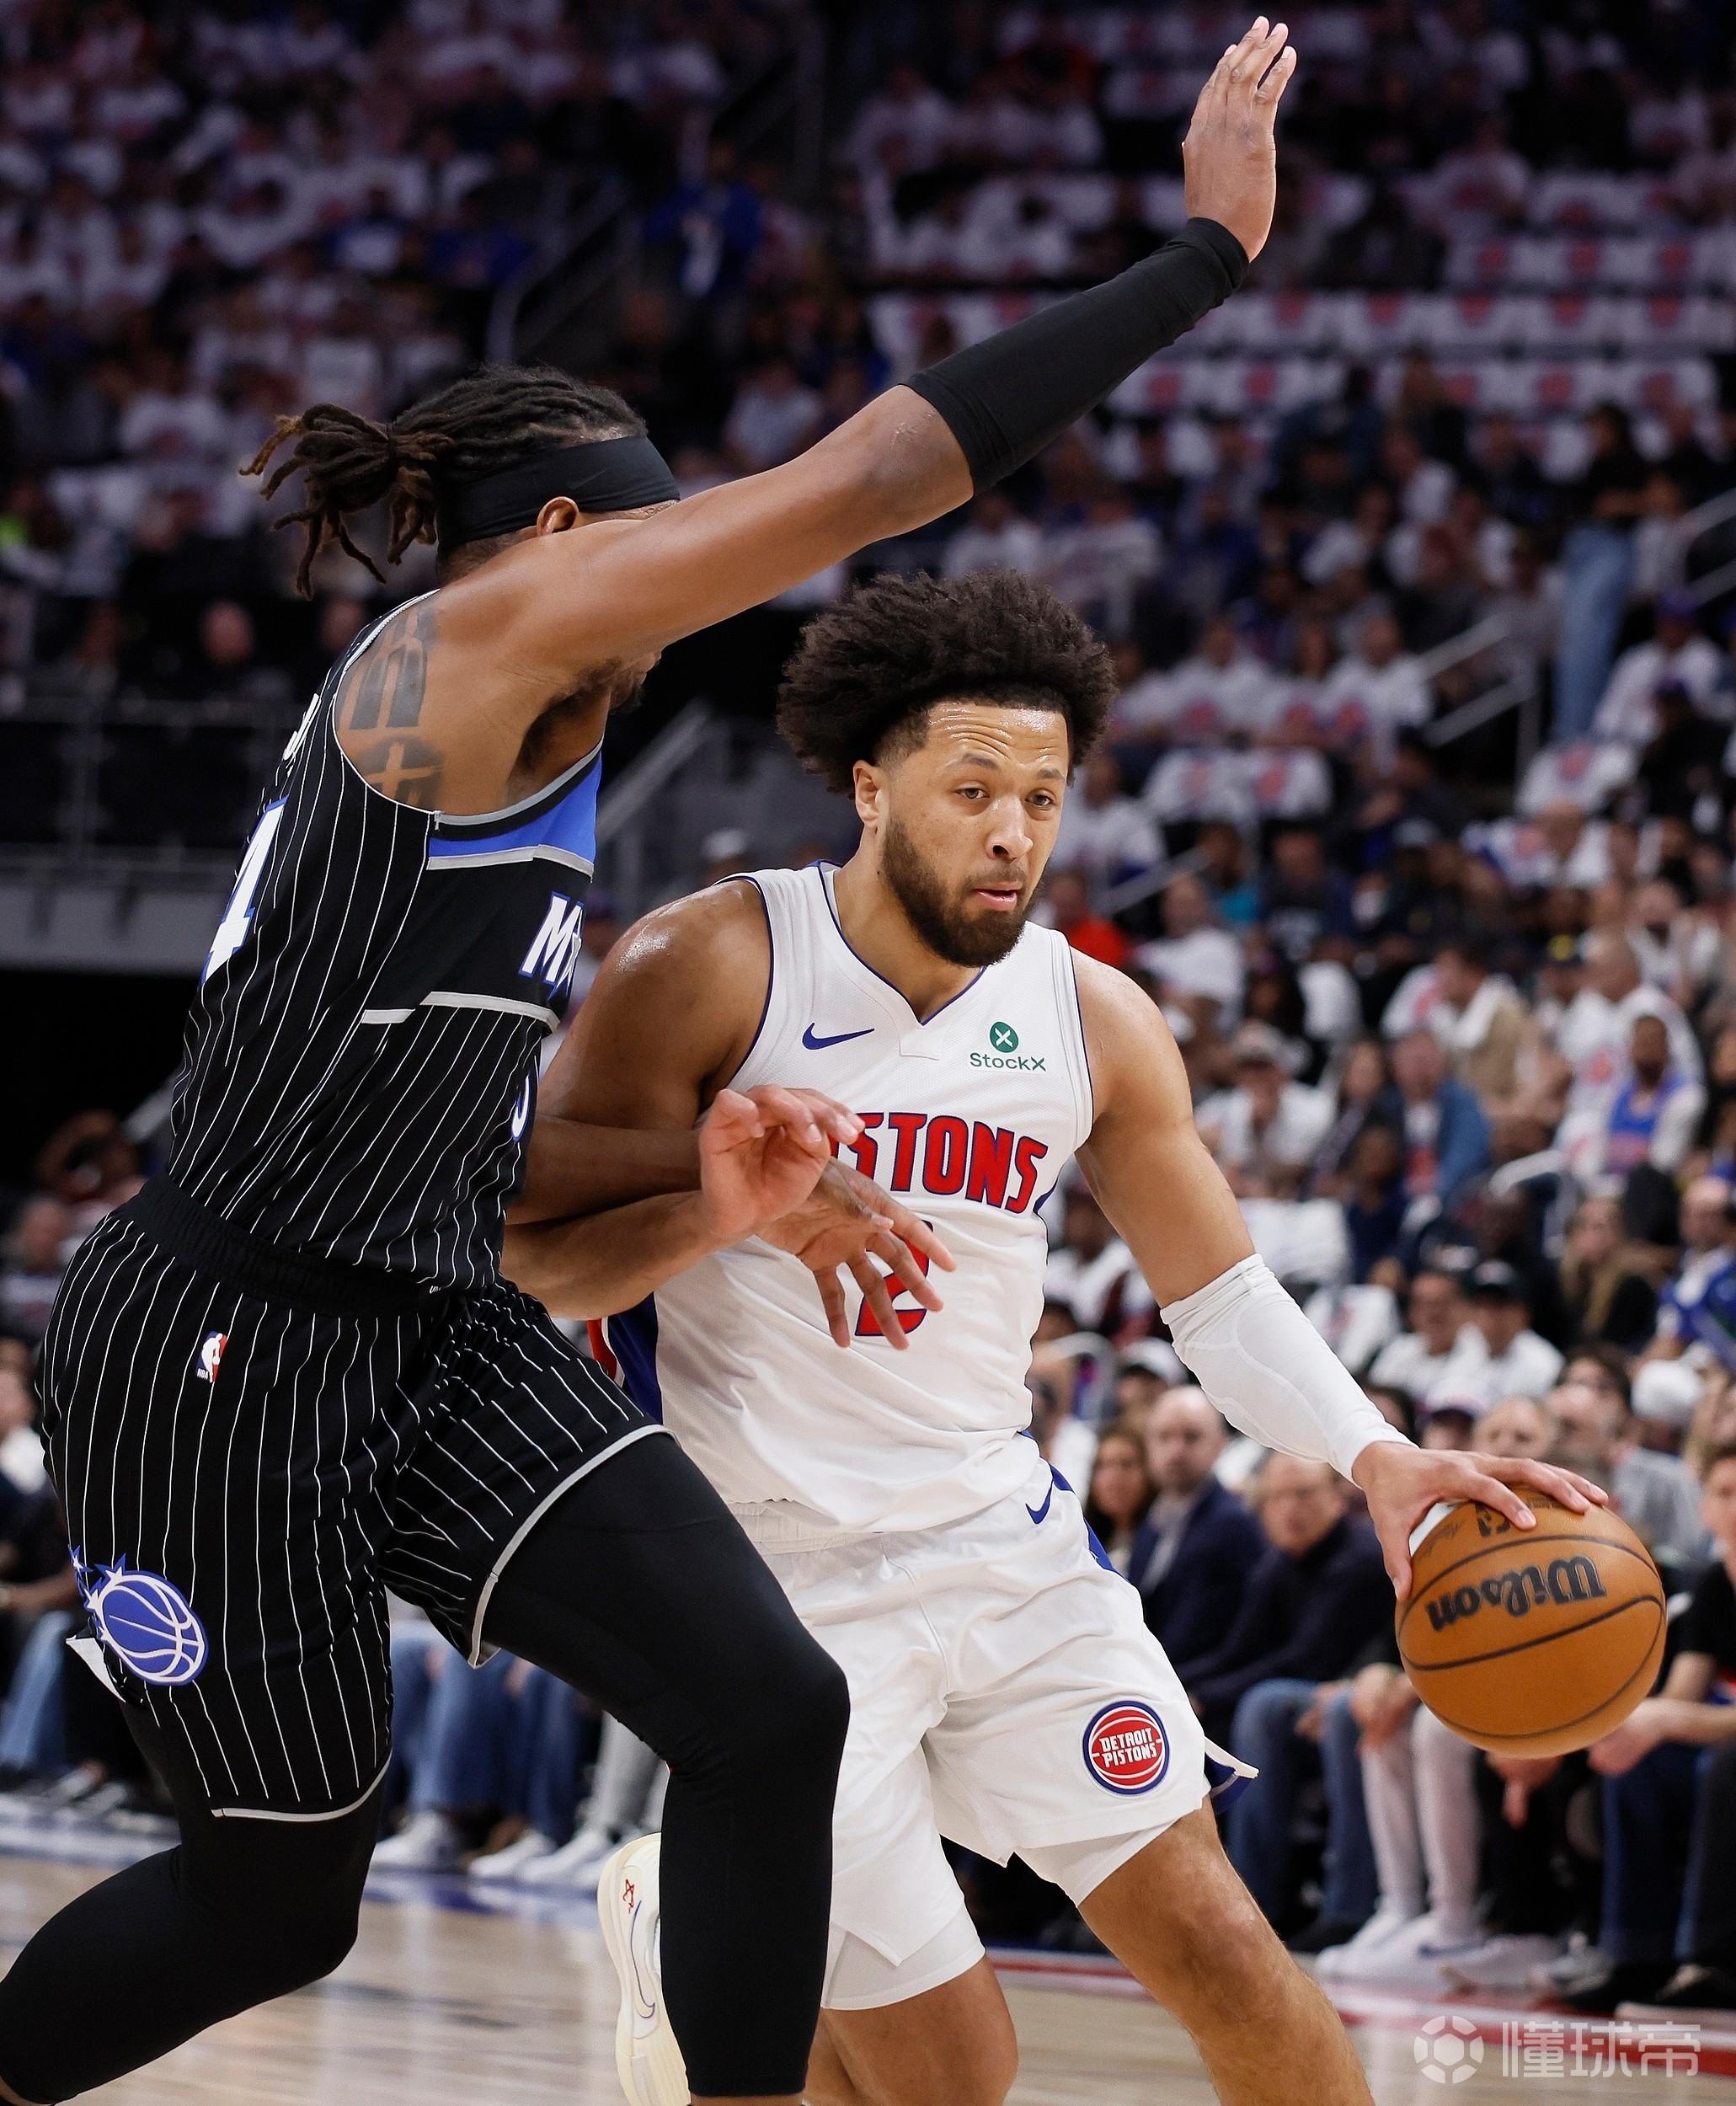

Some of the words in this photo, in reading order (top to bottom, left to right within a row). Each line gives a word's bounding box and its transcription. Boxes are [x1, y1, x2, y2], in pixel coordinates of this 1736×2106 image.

[518, 890, 583, 1000] M
[969, 1051, 1047, 1072] StockX
[829, 1111, 1049, 1215] STONS
[196, 1367, 209, 1380] NBA
[1424, 1555, 1608, 1633] Wilson
[1098, 1727, 1153, 1753] DETROIT
[1101, 1742, 1157, 1768] PISTONS
